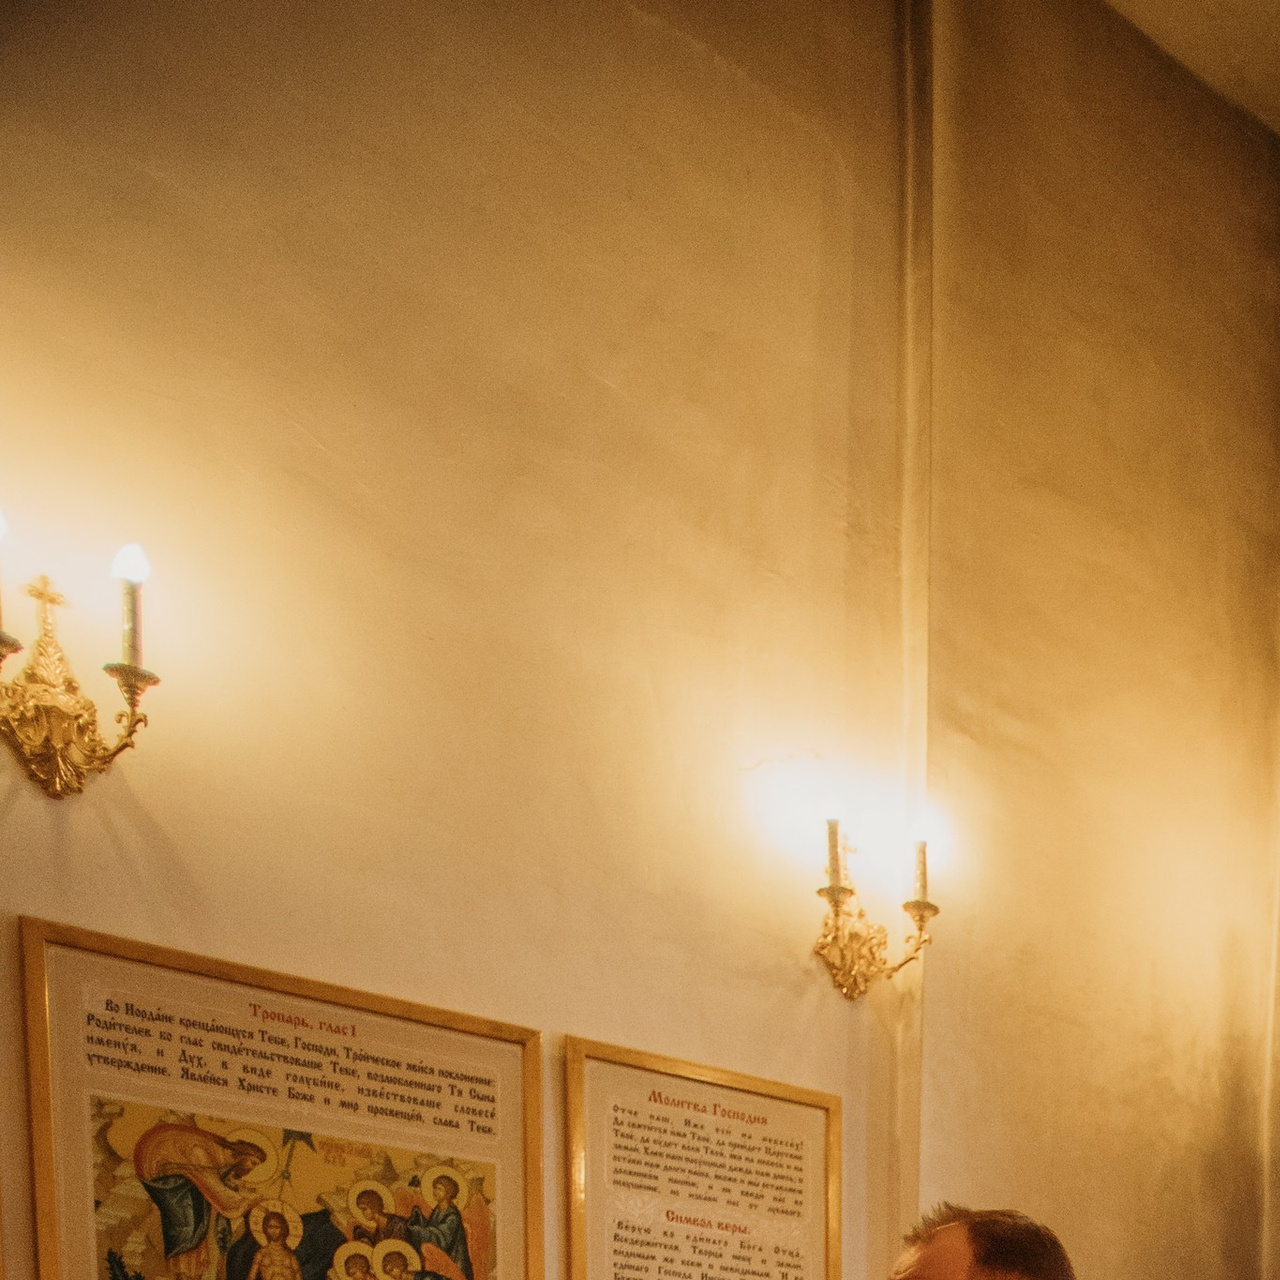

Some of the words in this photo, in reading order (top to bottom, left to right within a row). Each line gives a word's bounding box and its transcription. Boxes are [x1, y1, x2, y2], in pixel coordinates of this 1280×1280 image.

[647, 1089, 707, 1113] Молитва
[712, 1102, 767, 1125] Господня
[665, 1209, 712, 1228] Символ
